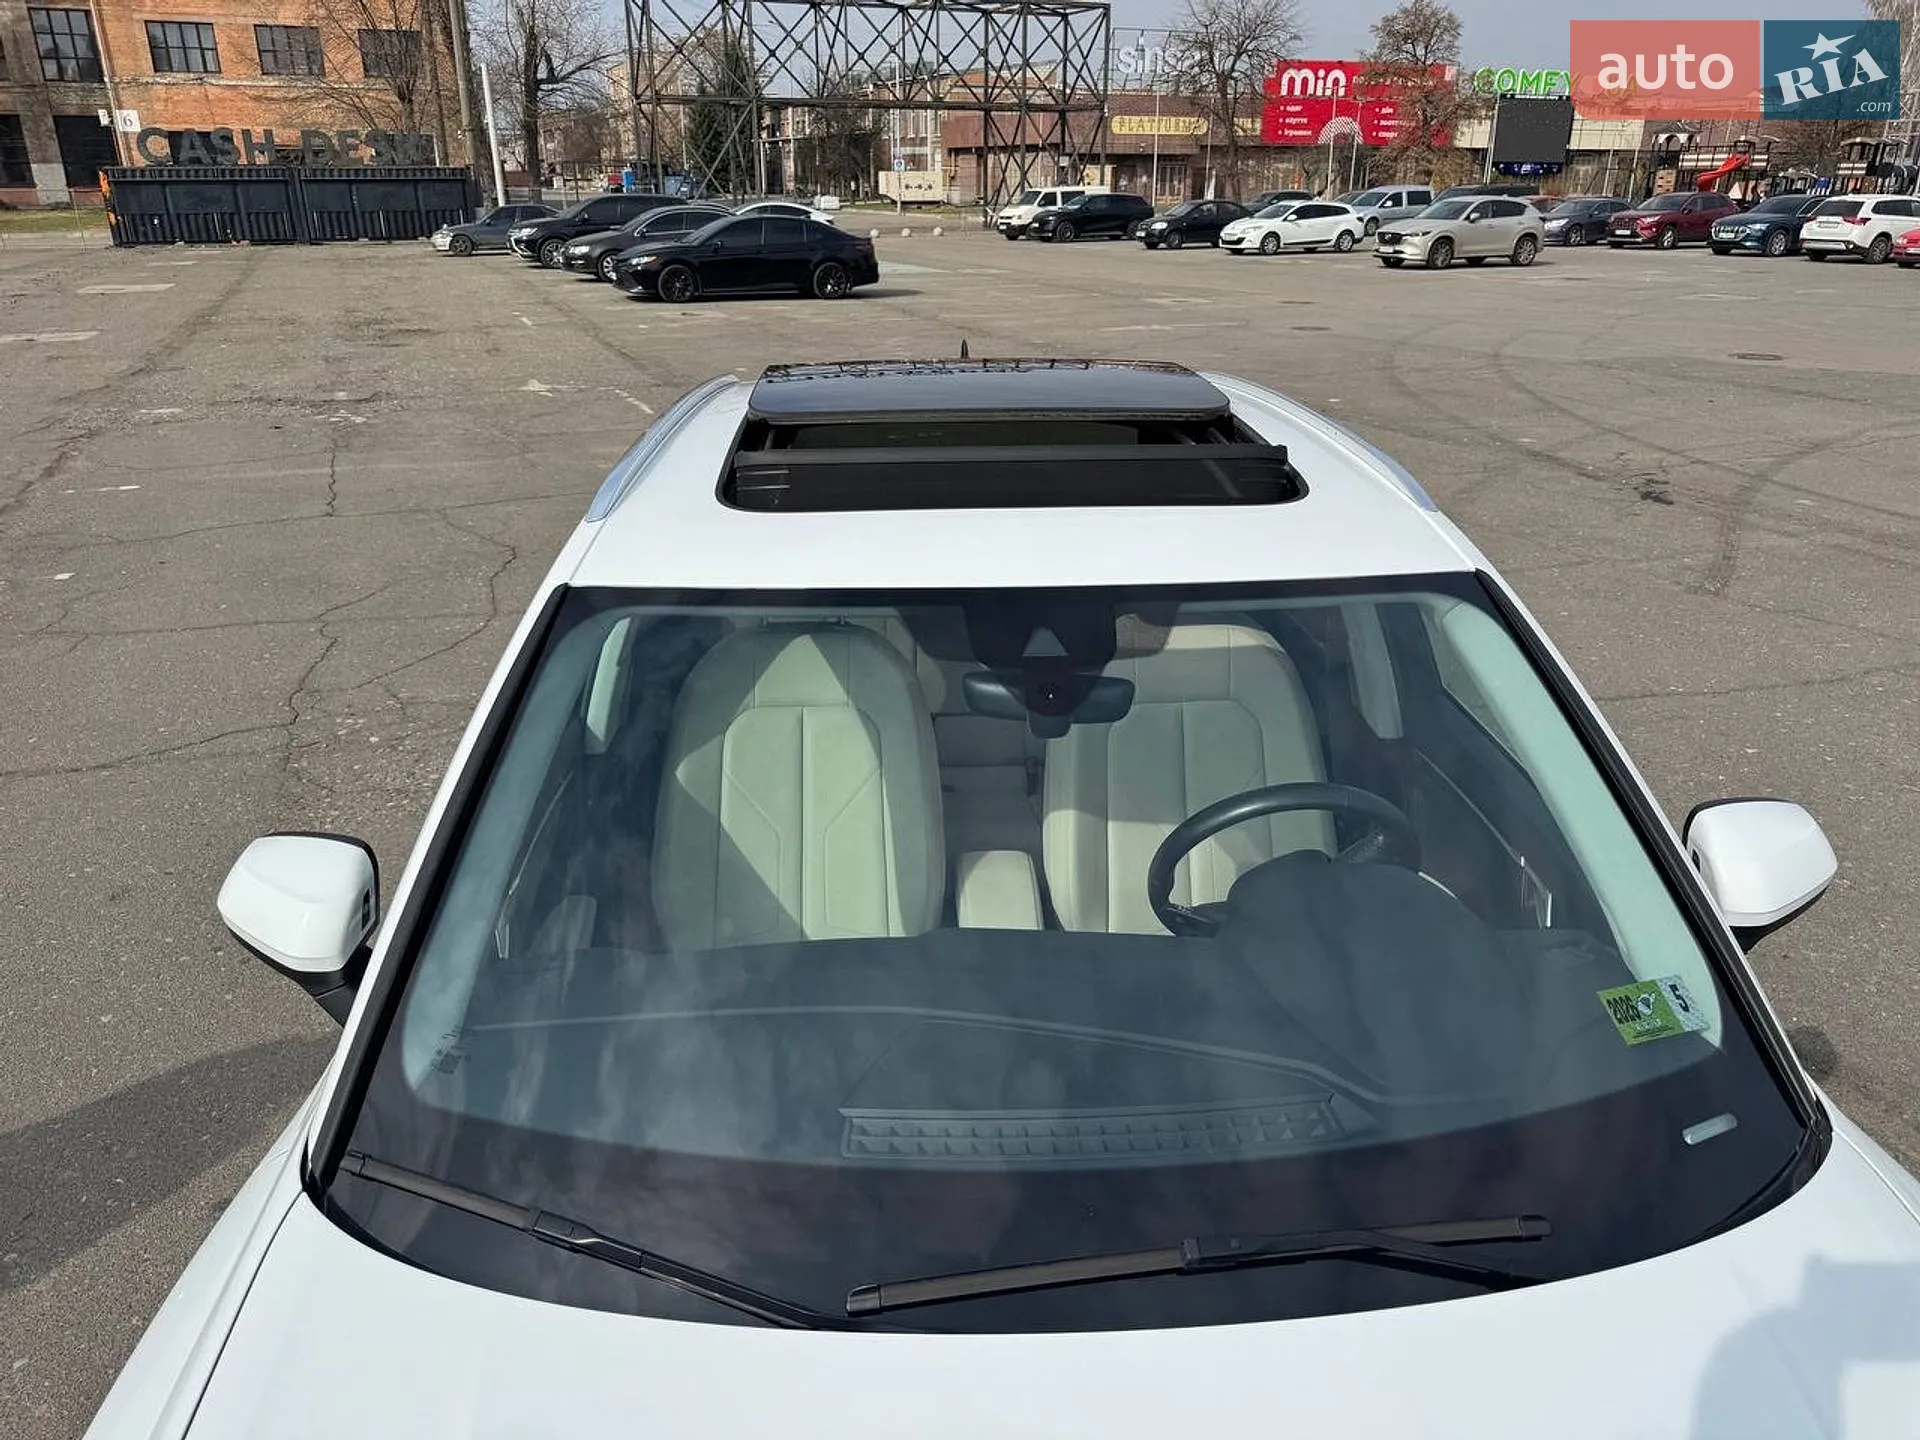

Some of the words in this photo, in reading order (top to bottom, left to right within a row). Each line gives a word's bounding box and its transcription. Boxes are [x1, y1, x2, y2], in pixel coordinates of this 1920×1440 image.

[1281, 68, 1346, 97] min
[137, 127, 275, 166] CASH
[1668, 984, 1690, 1013] 5
